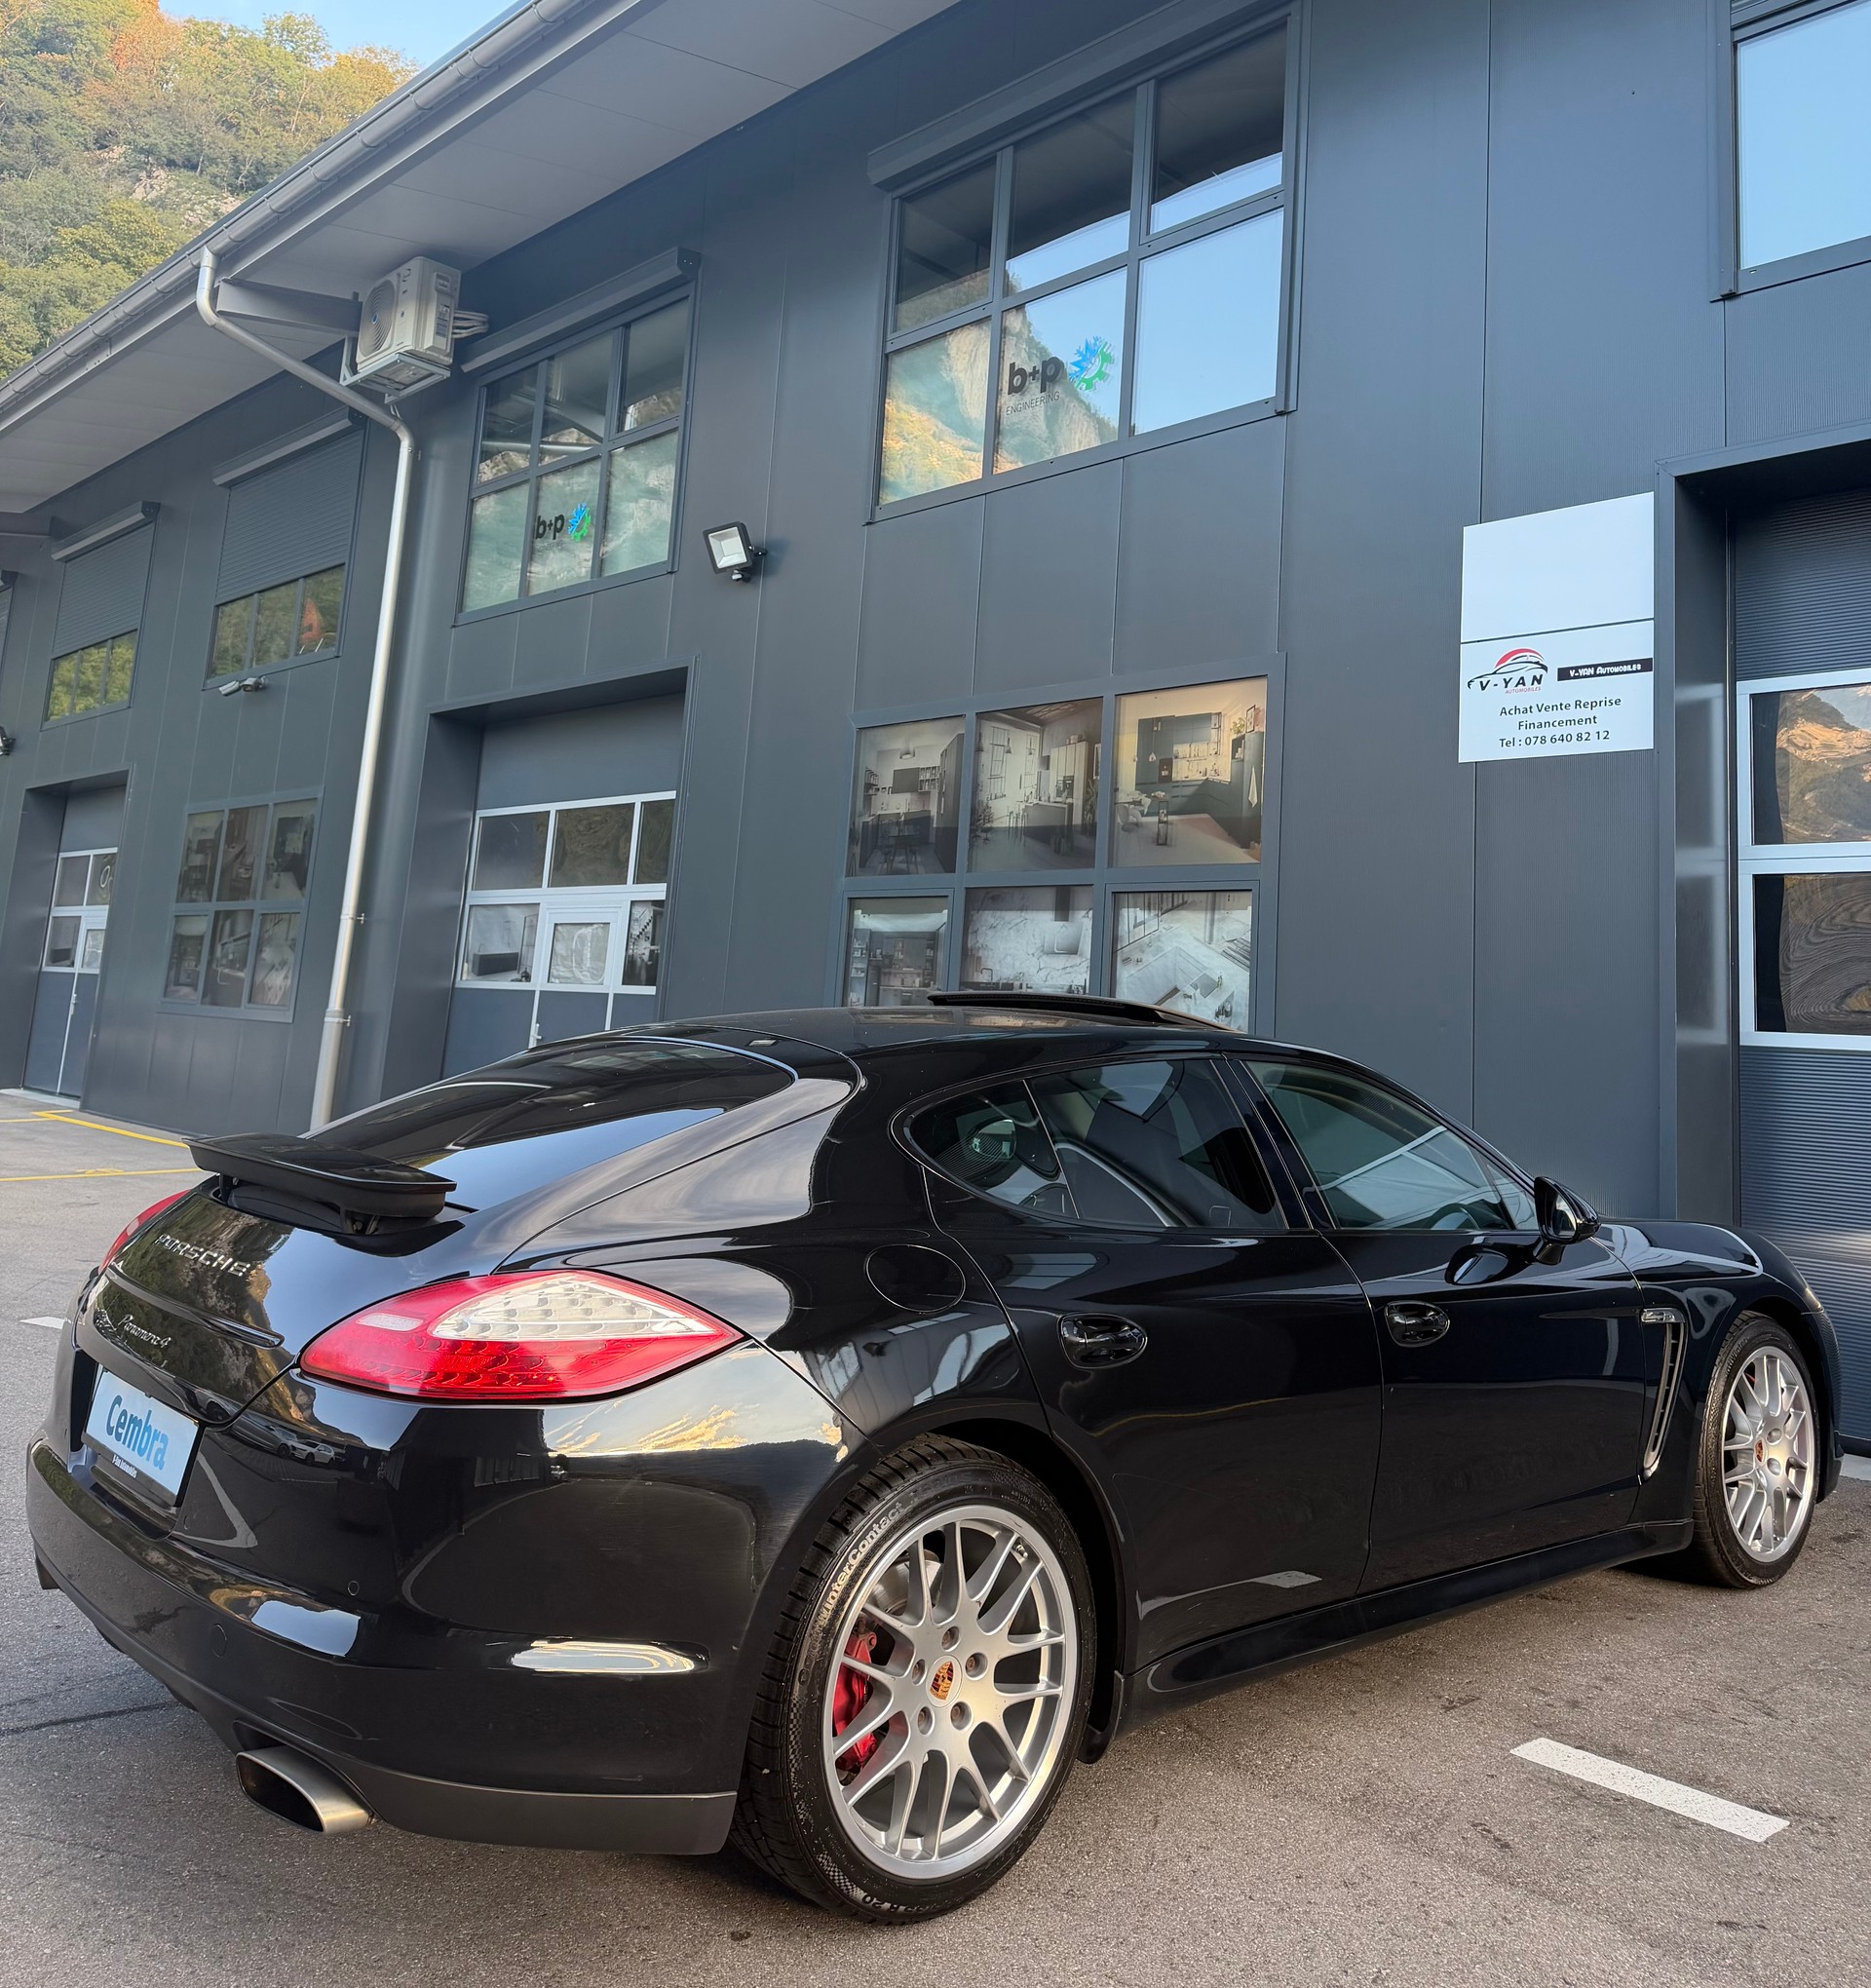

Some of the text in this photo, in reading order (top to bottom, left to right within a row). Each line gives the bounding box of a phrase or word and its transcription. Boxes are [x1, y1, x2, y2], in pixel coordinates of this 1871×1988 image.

[1008, 357, 1065, 395] b+p
[1006, 391, 1060, 415] ENGINEERING
[535, 515, 564, 540] b+p
[1479, 674, 1543, 691] V-YAN
[1570, 668, 1594, 677] V-YAN
[1500, 697, 1622, 716] Achat Vente Reprise
[1518, 715, 1597, 730] Financement
[1524, 735, 1547, 746] 078
[1549, 733, 1573, 744] 640
[1576, 732, 1591, 742] 82
[1595, 730, 1610, 740] 12
[154, 1233, 250, 1277] PORSCHE
[106, 1395, 170, 1471] Cembra
